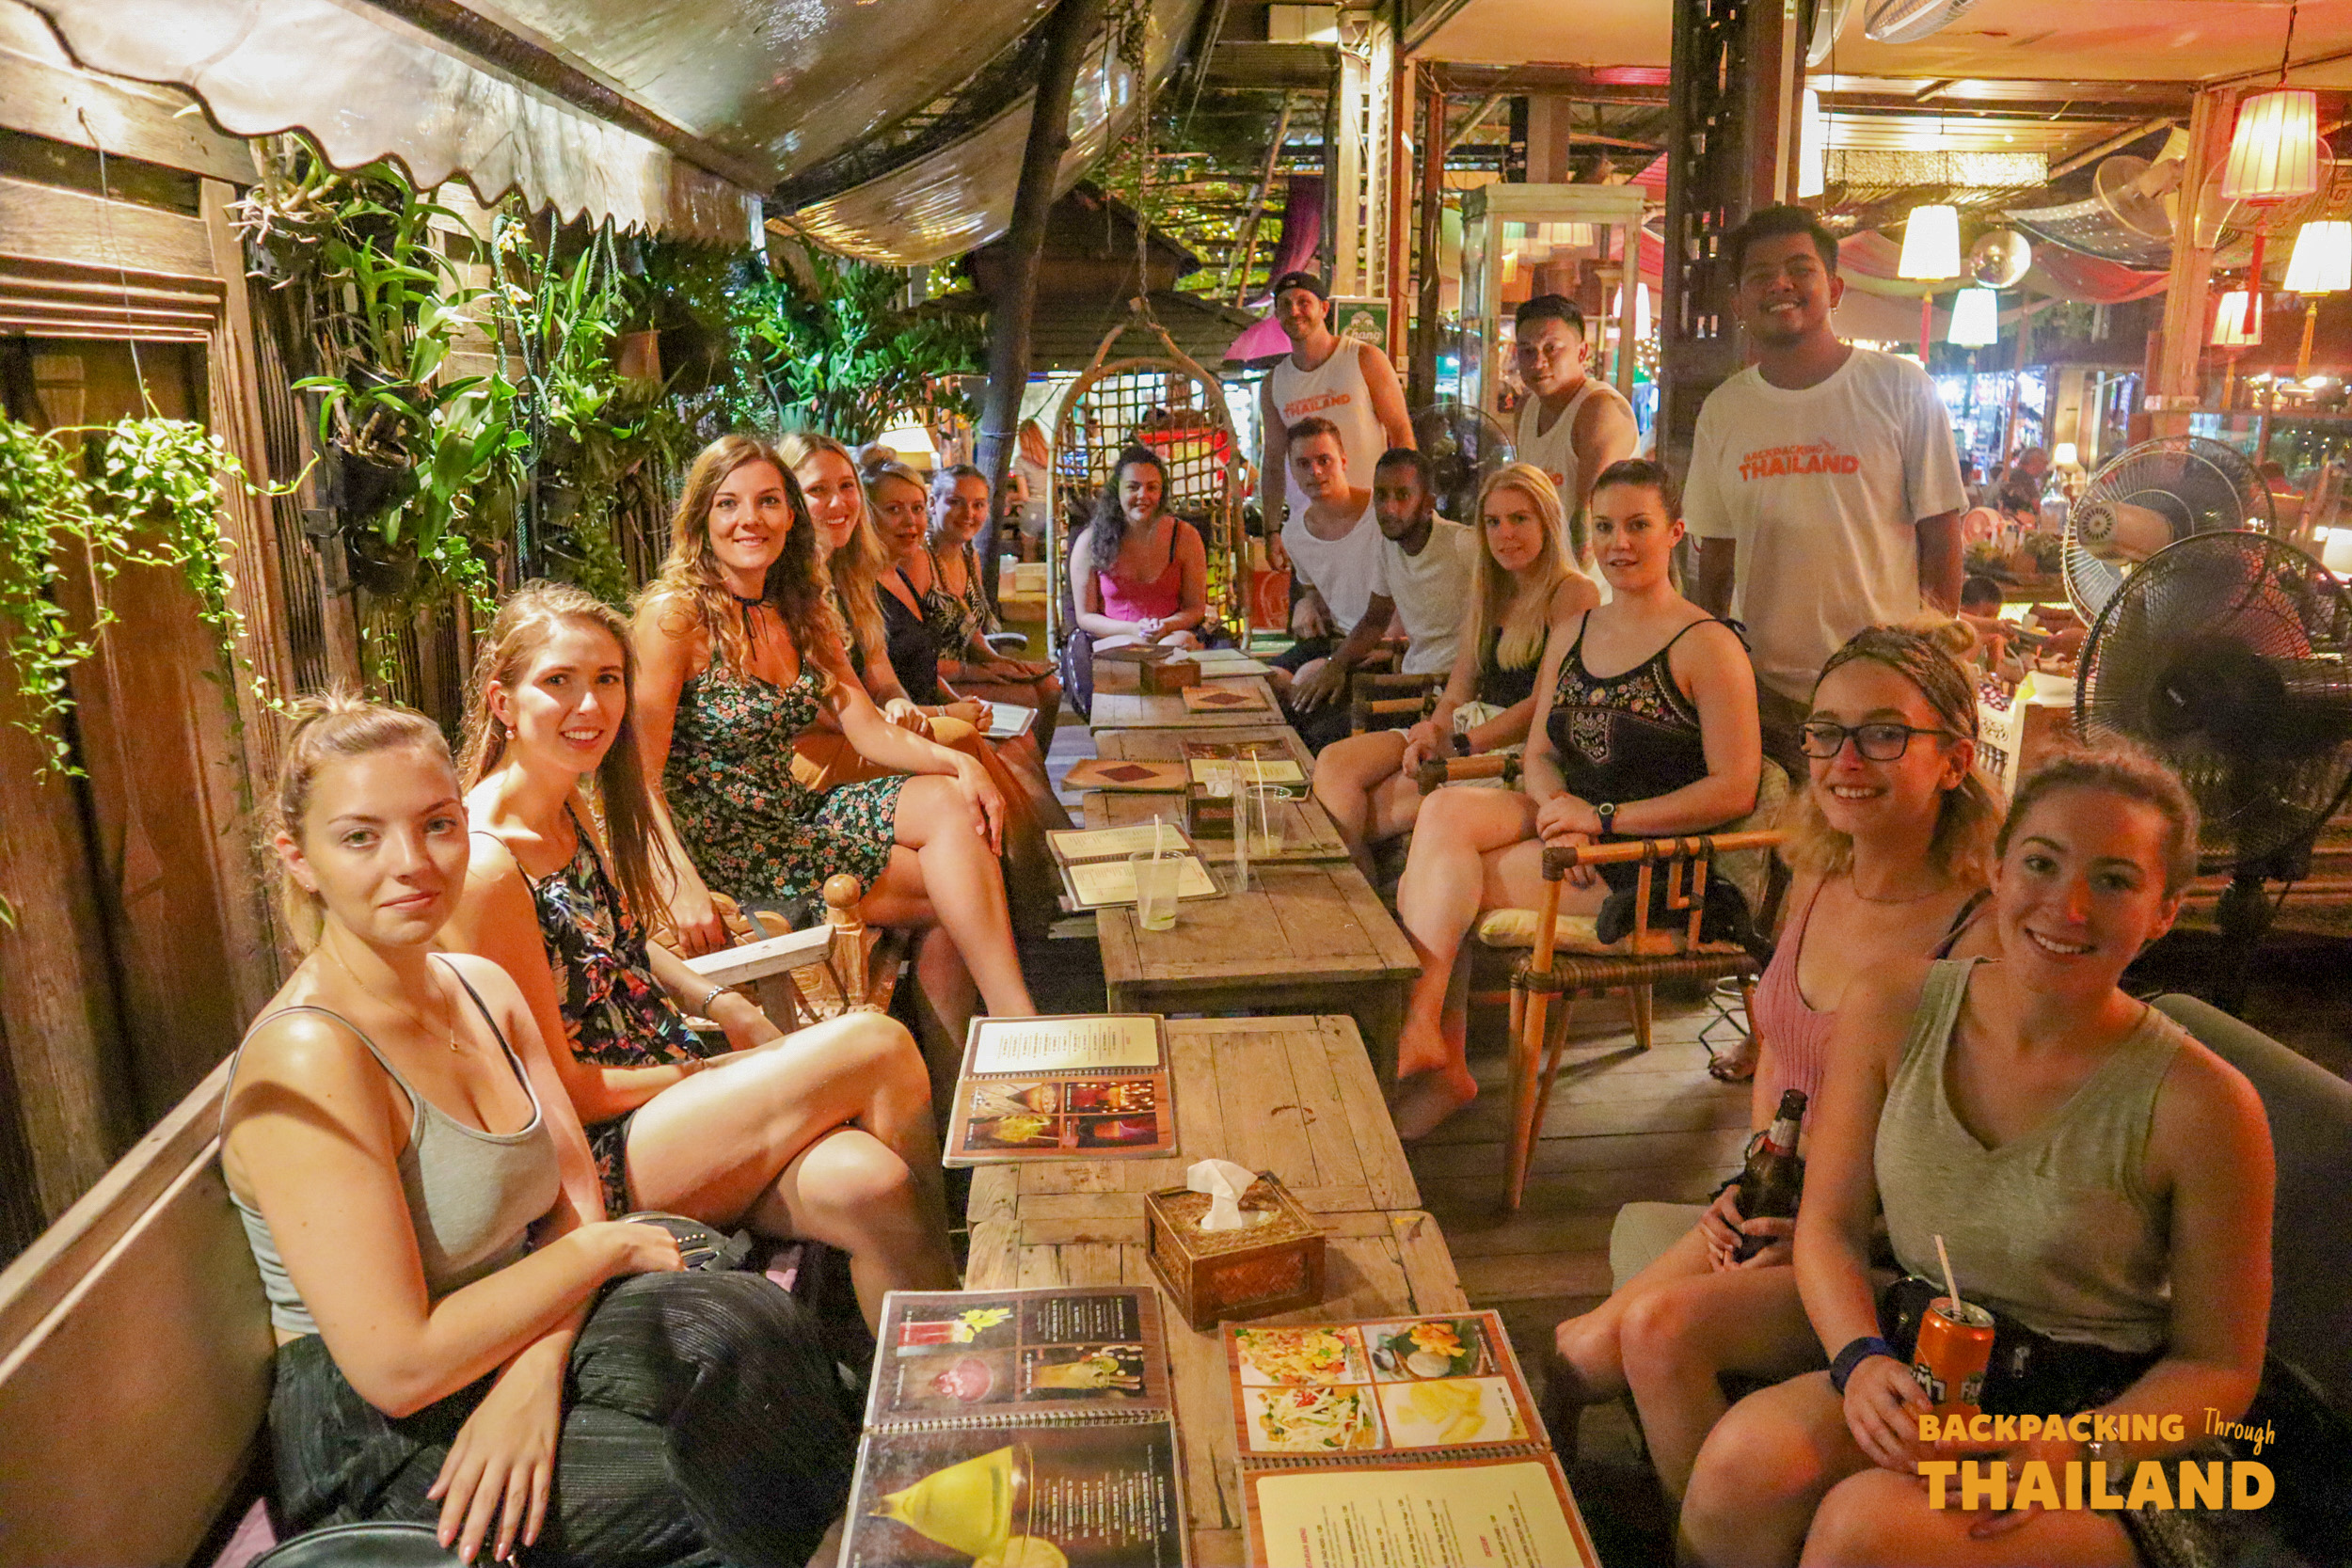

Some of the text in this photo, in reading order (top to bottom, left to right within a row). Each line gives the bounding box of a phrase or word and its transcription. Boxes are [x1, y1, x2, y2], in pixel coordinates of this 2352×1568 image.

[1343, 326, 1381, 341] Chang
[1283, 393, 1351, 418] THAILAND
[1743, 444, 1823, 463] BACKPACKING
[1739, 454, 1860, 482] THAILAND
